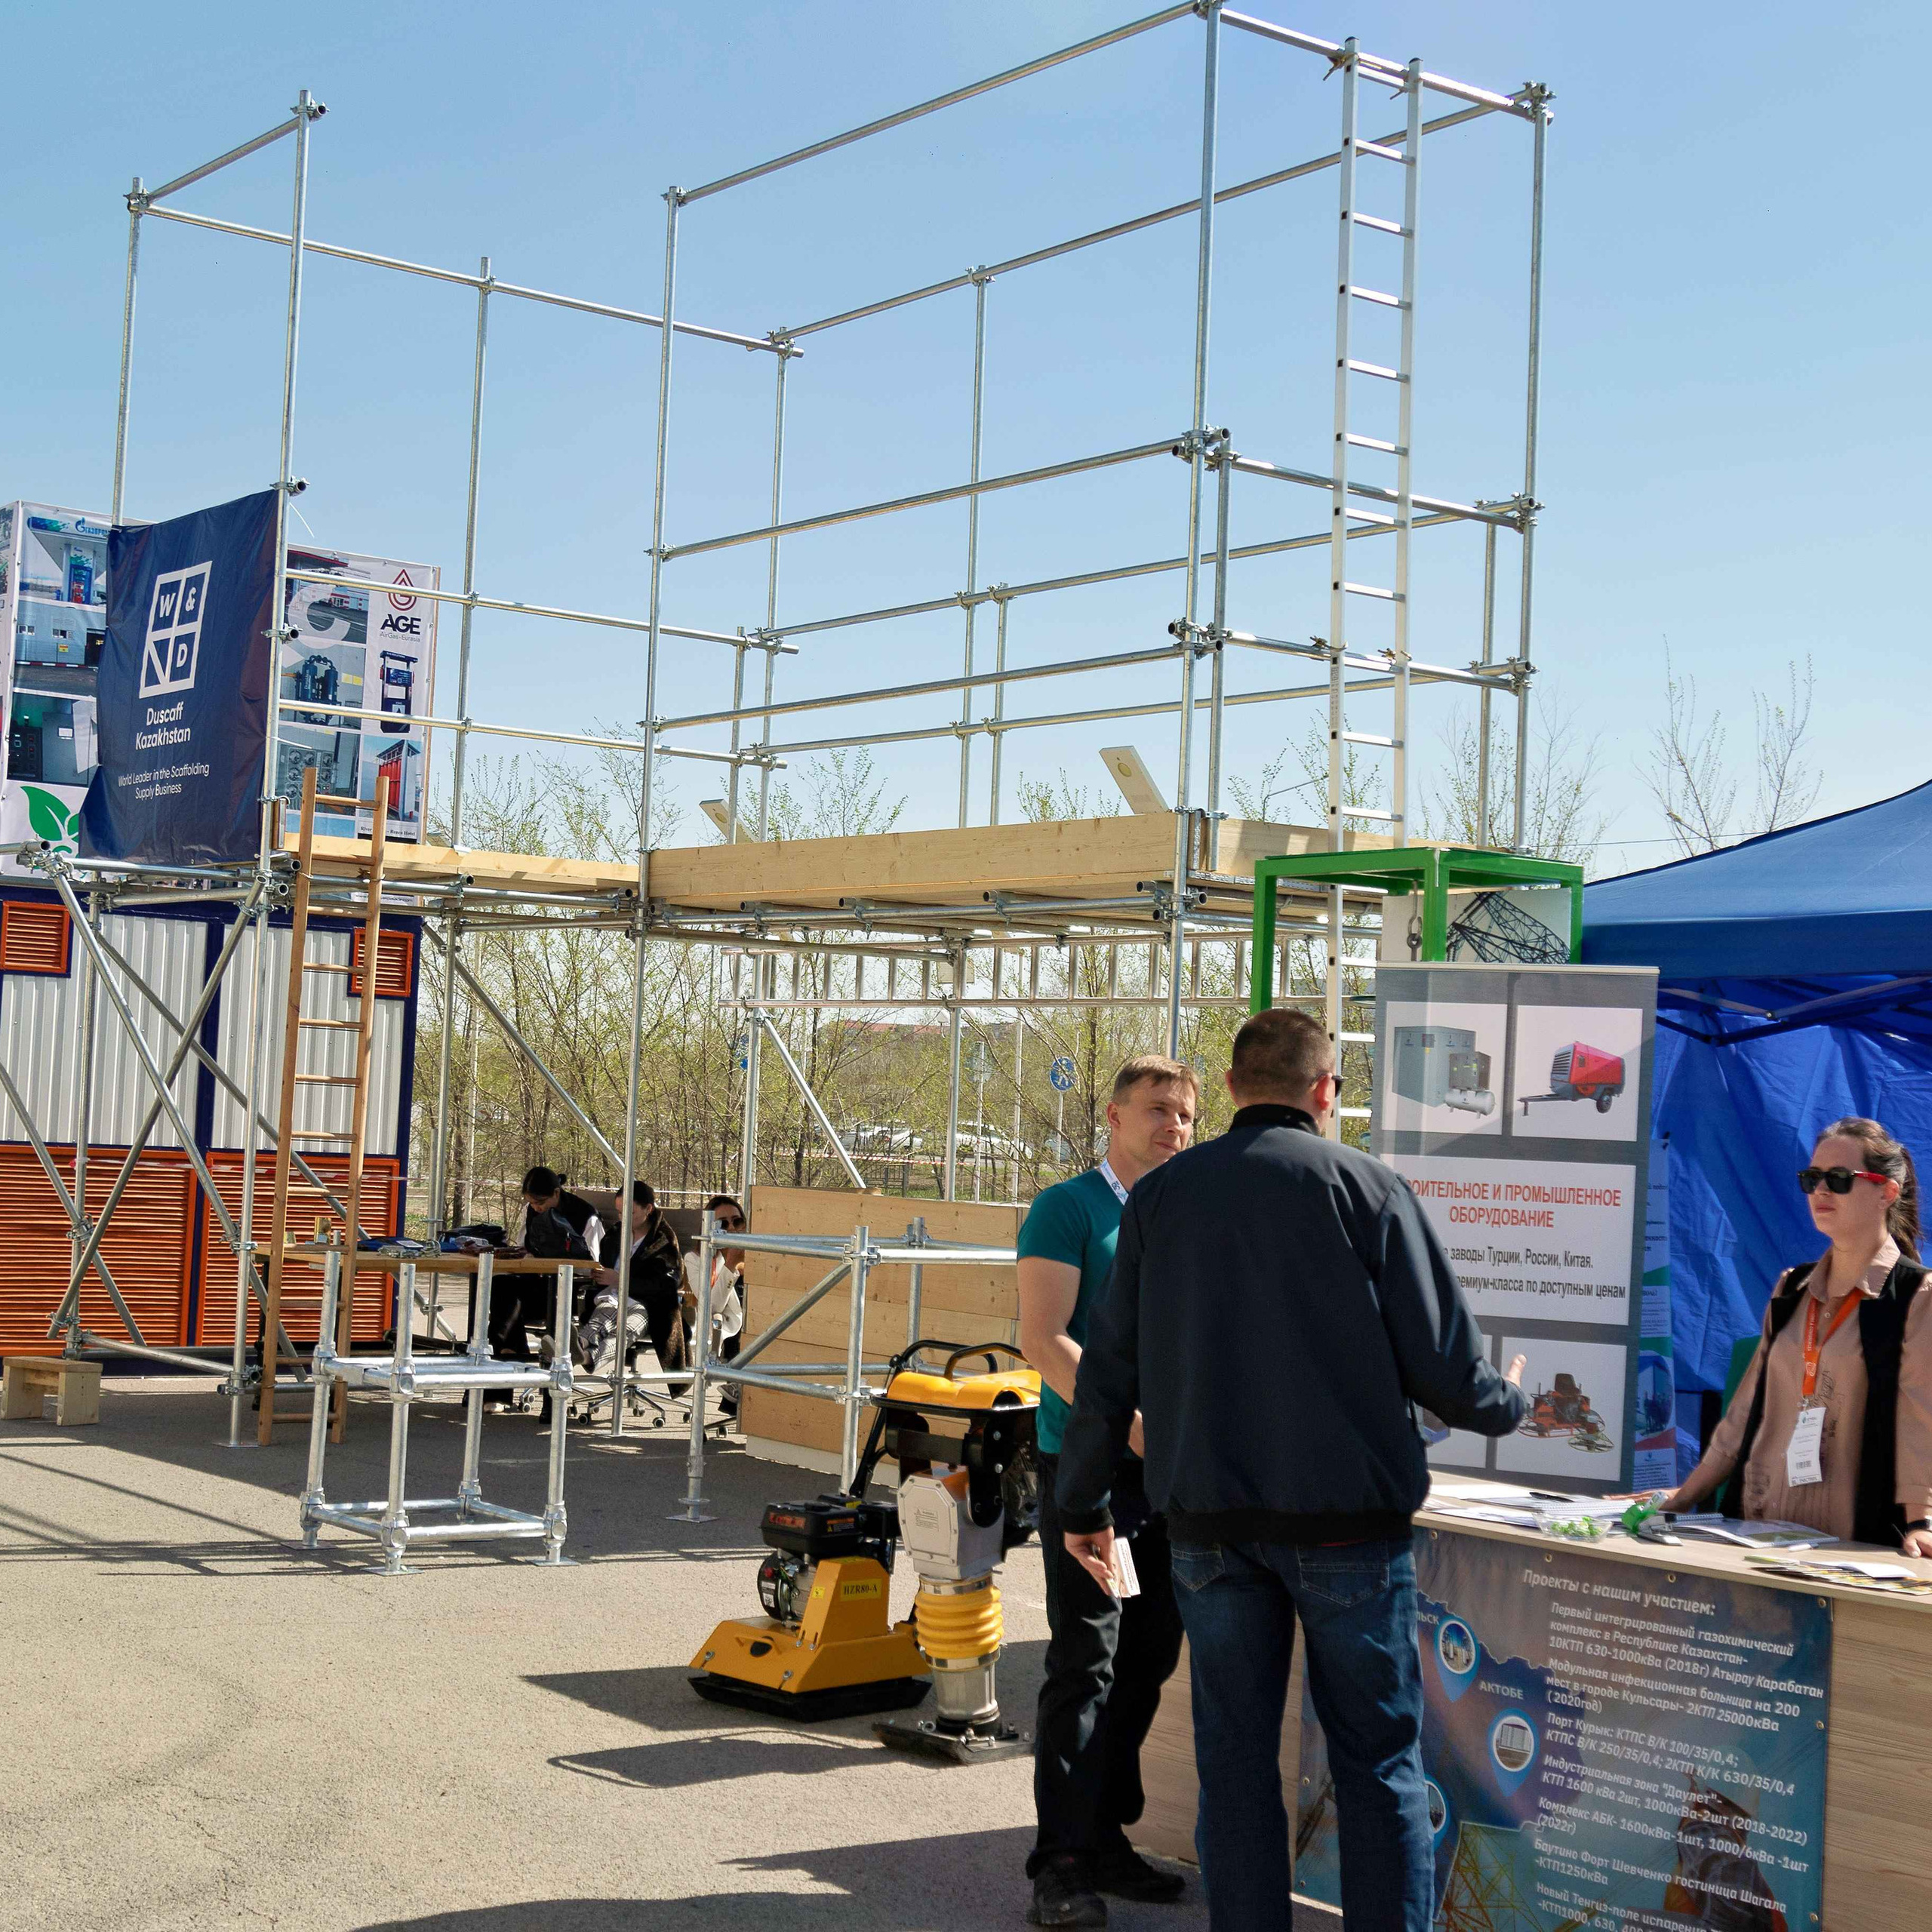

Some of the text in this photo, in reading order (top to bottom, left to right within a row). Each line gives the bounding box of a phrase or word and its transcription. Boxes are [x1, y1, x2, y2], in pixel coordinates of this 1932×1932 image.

[159, 587, 197, 618] W &
[380, 614, 421, 635] AGE
[177, 643, 188, 668] D
[146, 702, 184, 726] Duscaff
[135, 727, 191, 750] Kazakhstan
[118, 763, 210, 787] World Leader in the Scaffolding
[135, 782, 182, 800] Supply Business
[1408, 1180, 1622, 1208] ОИТЕЛЬНОЕ И ПРОМЫШЛЕННОЕ
[1449, 1205, 1555, 1229] ОБОРУДОВАНИЕ
[1451, 1247, 1485, 1263] заводы
[1487, 1246, 1523, 1267] Турции,
[1525, 1248, 1561, 1269] России,
[1564, 1250, 1594, 1269] Китая.
[1526, 1278, 1538, 1292] по
[1540, 1280, 1593, 1299] доступным
[1596, 1284, 1626, 1299] ценам
[844, 1583, 878, 1595] HZR80-A
[1524, 1570, 1717, 1617] Проекты с нашим участием:
[1550, 1622, 1749, 1666] комплекс в Республике Казахстан-
[1552, 1602, 1795, 1657] Первый интегрированный газохимический
[1549, 1637, 1824, 1698] 10КТП 630-1000кВа (2018г) Атырау Карабатан
[1479, 1680, 1524, 1700] АКТОБЕ
[1549, 1658, 1801, 1717] Модульная инфекционная больница на 200
[1546, 1676, 1780, 1731] мест в городе Кульсары- 2КТП 25000кВа
[1548, 1712, 1574, 1729] Порт
[1576, 1718, 1614, 1737] Курык:
[1617, 1728, 1646, 1745] КТПС
[1544, 1755, 1632, 1786] Индустриальная
[1634, 1779, 1660, 1794] зона
[1546, 1730, 1576, 1746] КТПС
[1666, 1758, 1695, 1775] 2КТП
[1724, 1772, 1795, 1796] 630/35/0,4
[1539, 1797, 1590, 1820] Комплекс
[1592, 1810, 1618, 1827] АБК-
[1543, 1772, 1564, 1787] КТП
[1567, 1778, 1594, 1794] 1600
[1595, 1786, 1616, 1800] кВа
[1617, 1790, 1641, 1808] 2шт,
[1731, 1815, 1808, 1847] (2018-2022)
[1537, 1814, 1577, 1835] (2022г)
[1534, 1857, 1609, 1885] -КТП1250кВа
[1534, 1838, 1787, 1914] Баутино Форт Шевченко гостиница Шагала
[1537, 1881, 1570, 1903] Новый
[1572, 1892, 1640, 1921] Тенгиз-поле
